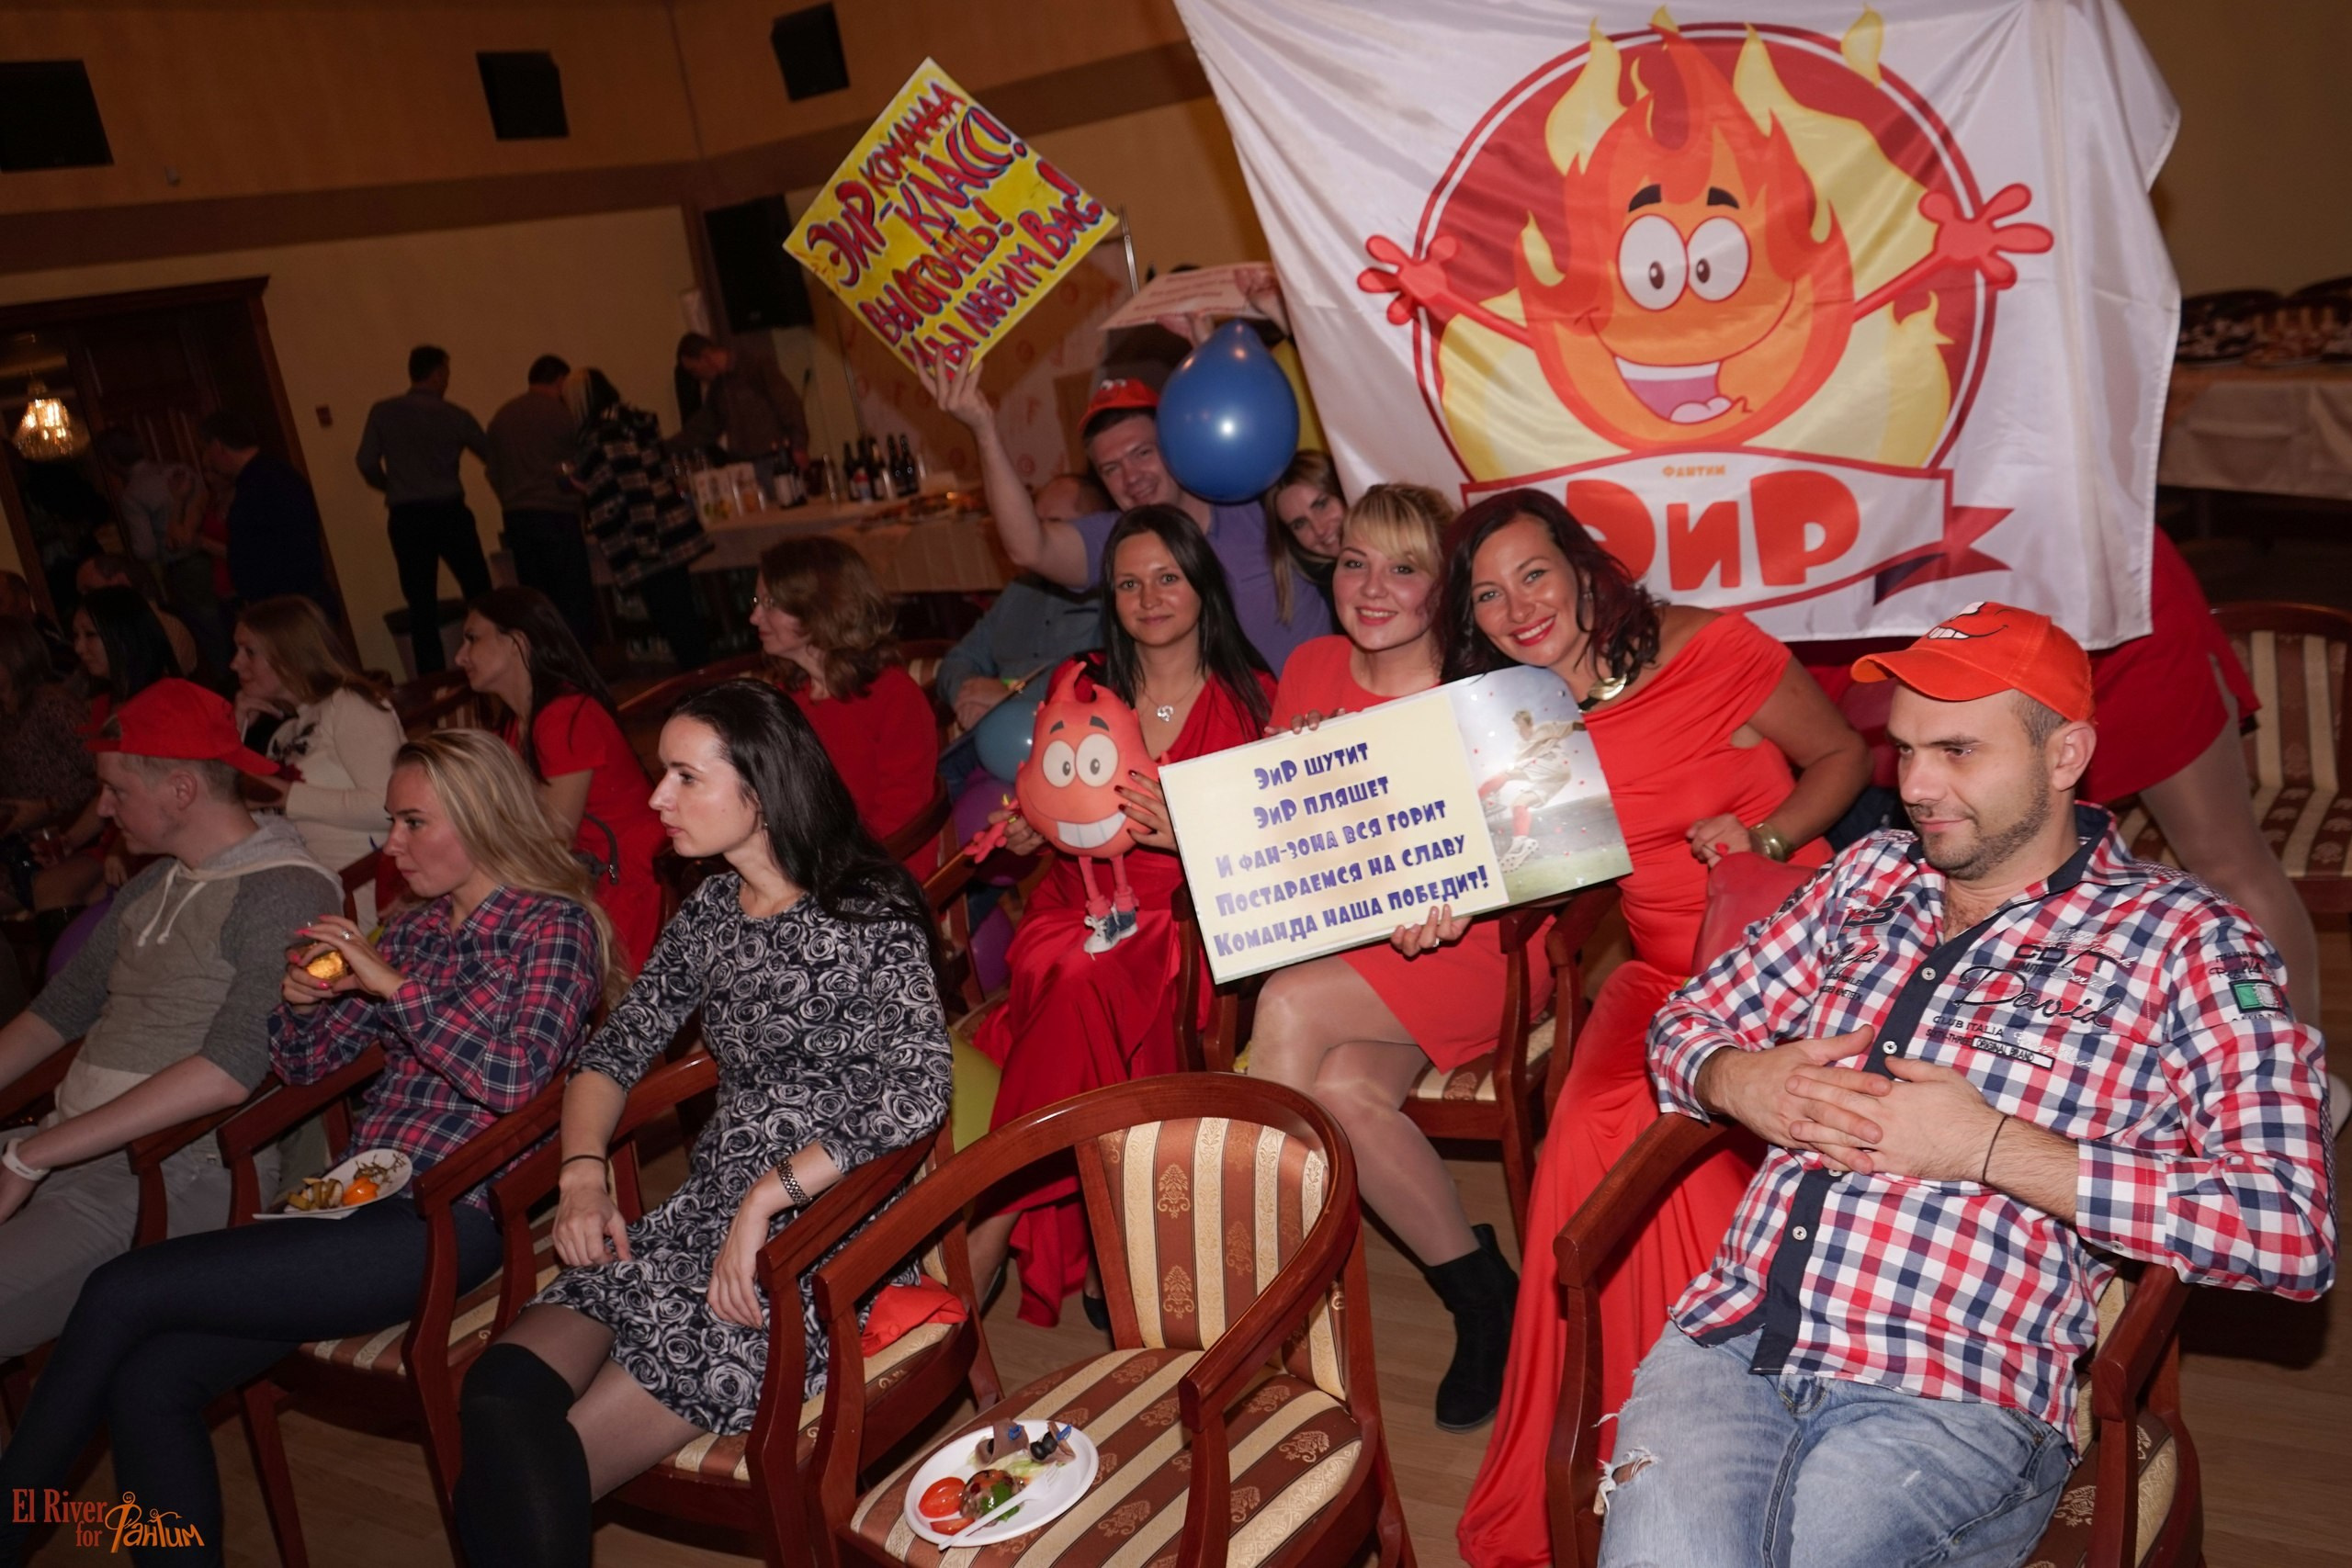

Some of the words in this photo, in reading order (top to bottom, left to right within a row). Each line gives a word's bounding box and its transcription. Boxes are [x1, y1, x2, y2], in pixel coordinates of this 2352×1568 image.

[859, 83, 967, 198] КОМАНДА
[955, 243, 1057, 338] ЛЮБИМ
[1215, 854, 1234, 879] И
[1932, 1015, 1964, 1029] CLUB
[1966, 1021, 2004, 1038] ITALIA
[1953, 964, 2122, 1030] David
